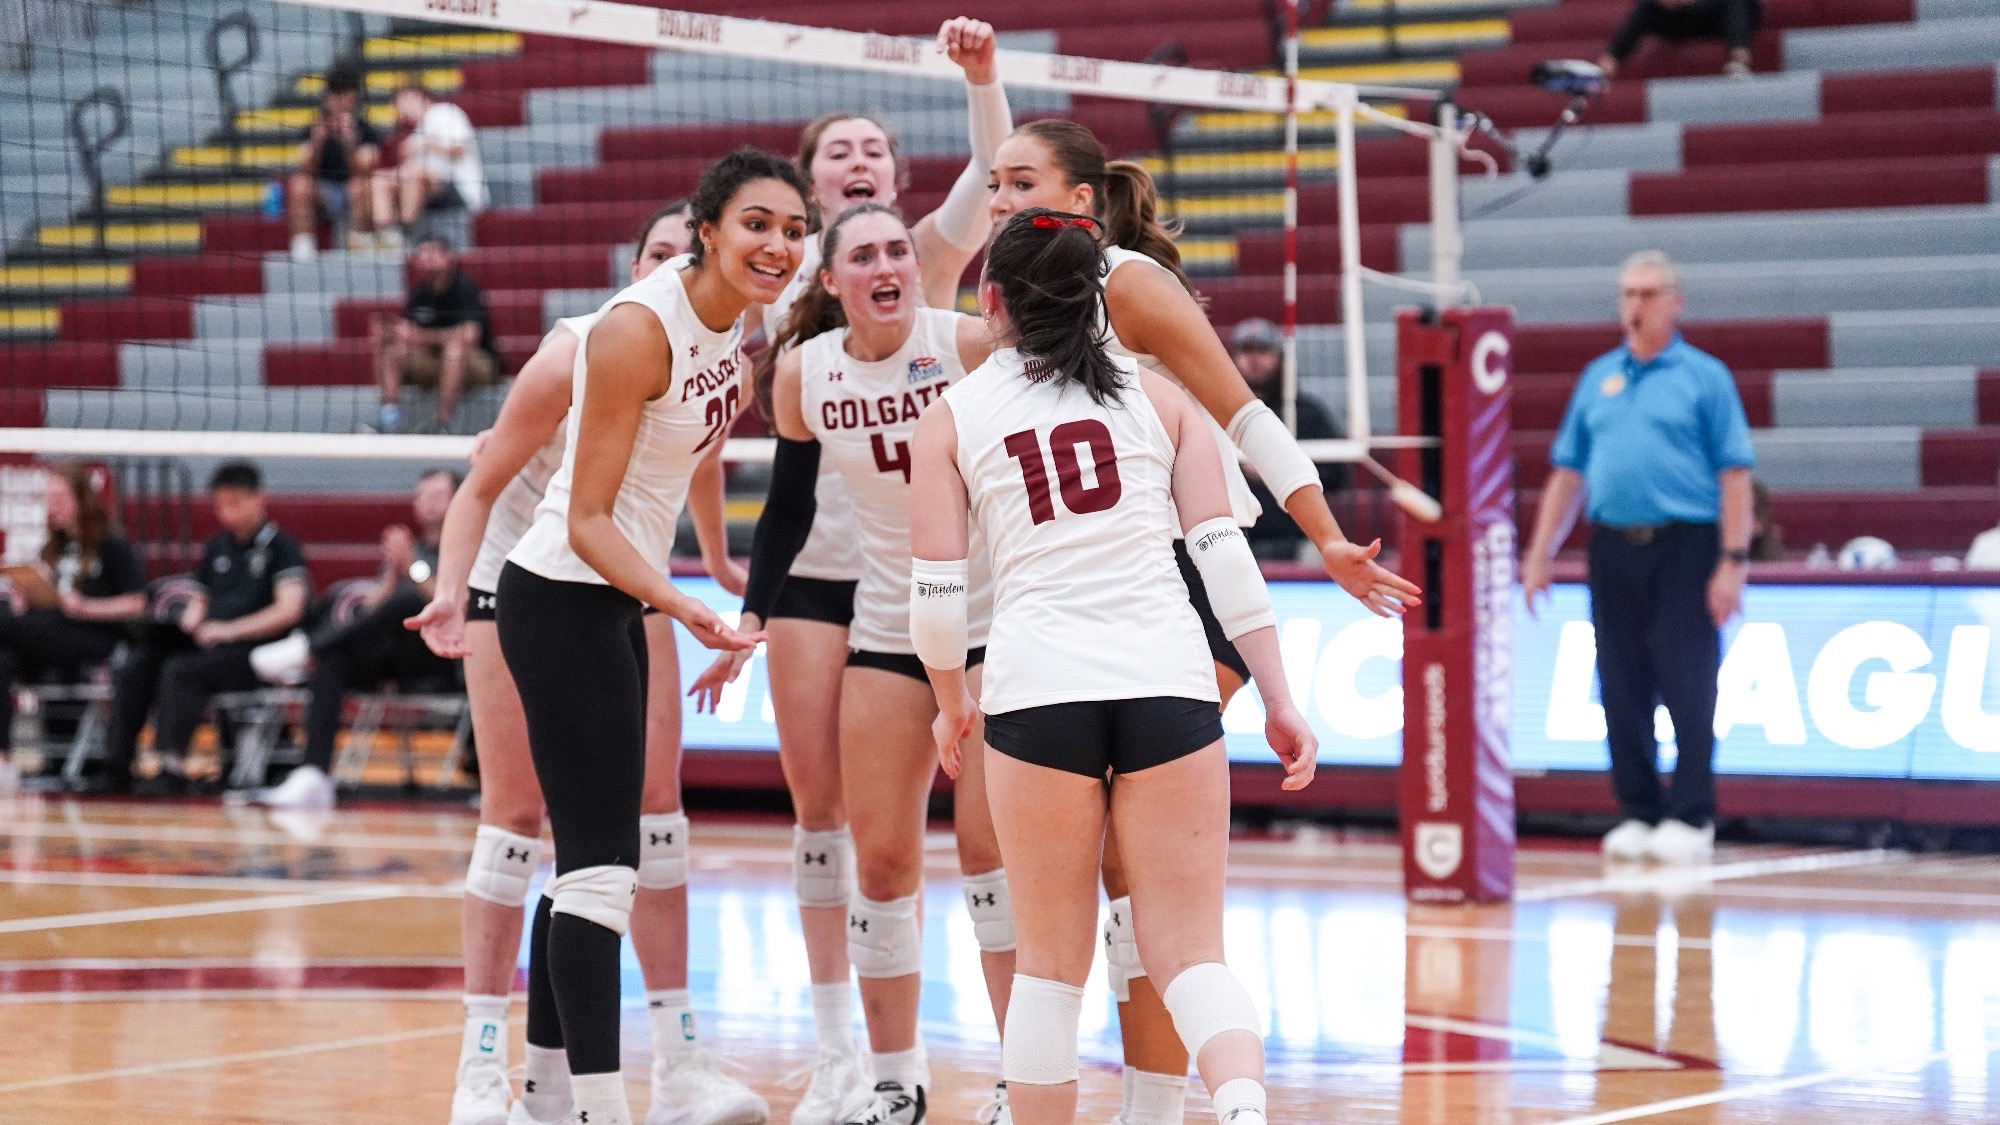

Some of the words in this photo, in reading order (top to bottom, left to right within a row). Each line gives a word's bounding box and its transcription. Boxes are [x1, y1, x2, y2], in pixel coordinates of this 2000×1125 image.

[1472, 331, 1509, 394] C
[870, 433, 911, 484] 4
[1003, 418, 1122, 526] 10
[917, 581, 965, 599] Tandem
